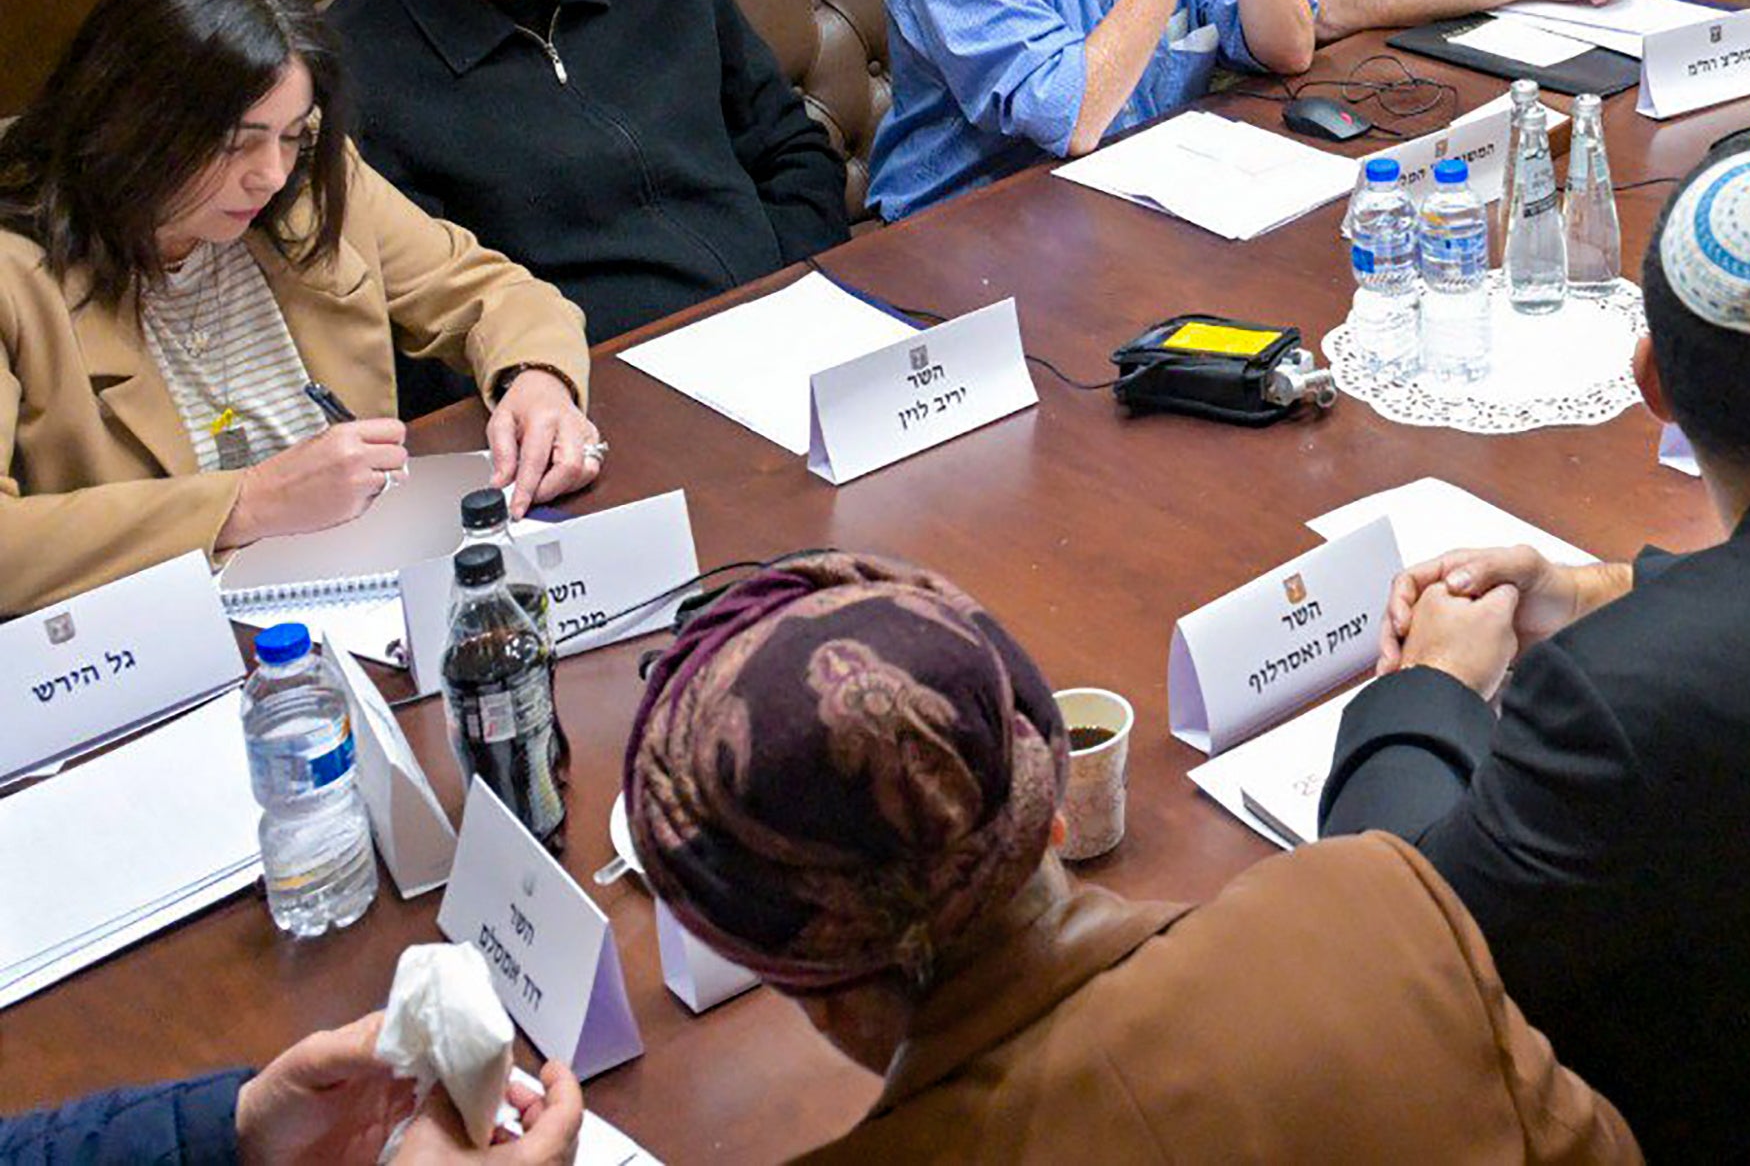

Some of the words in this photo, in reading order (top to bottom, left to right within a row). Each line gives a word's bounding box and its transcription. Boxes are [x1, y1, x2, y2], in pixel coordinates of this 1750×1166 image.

[907, 365, 945, 388] השר
[898, 400, 929, 430] לוין
[934, 387, 967, 413] יריב
[1282, 601, 1322, 630] השר
[1326, 613, 1369, 654] יצחק
[104, 650, 136, 674] גל
[1249, 640, 1323, 694] ואסרלוף
[32, 665, 100, 702] הירש
[510, 903, 535, 946] השר
[523, 974, 543, 1012] דוד
